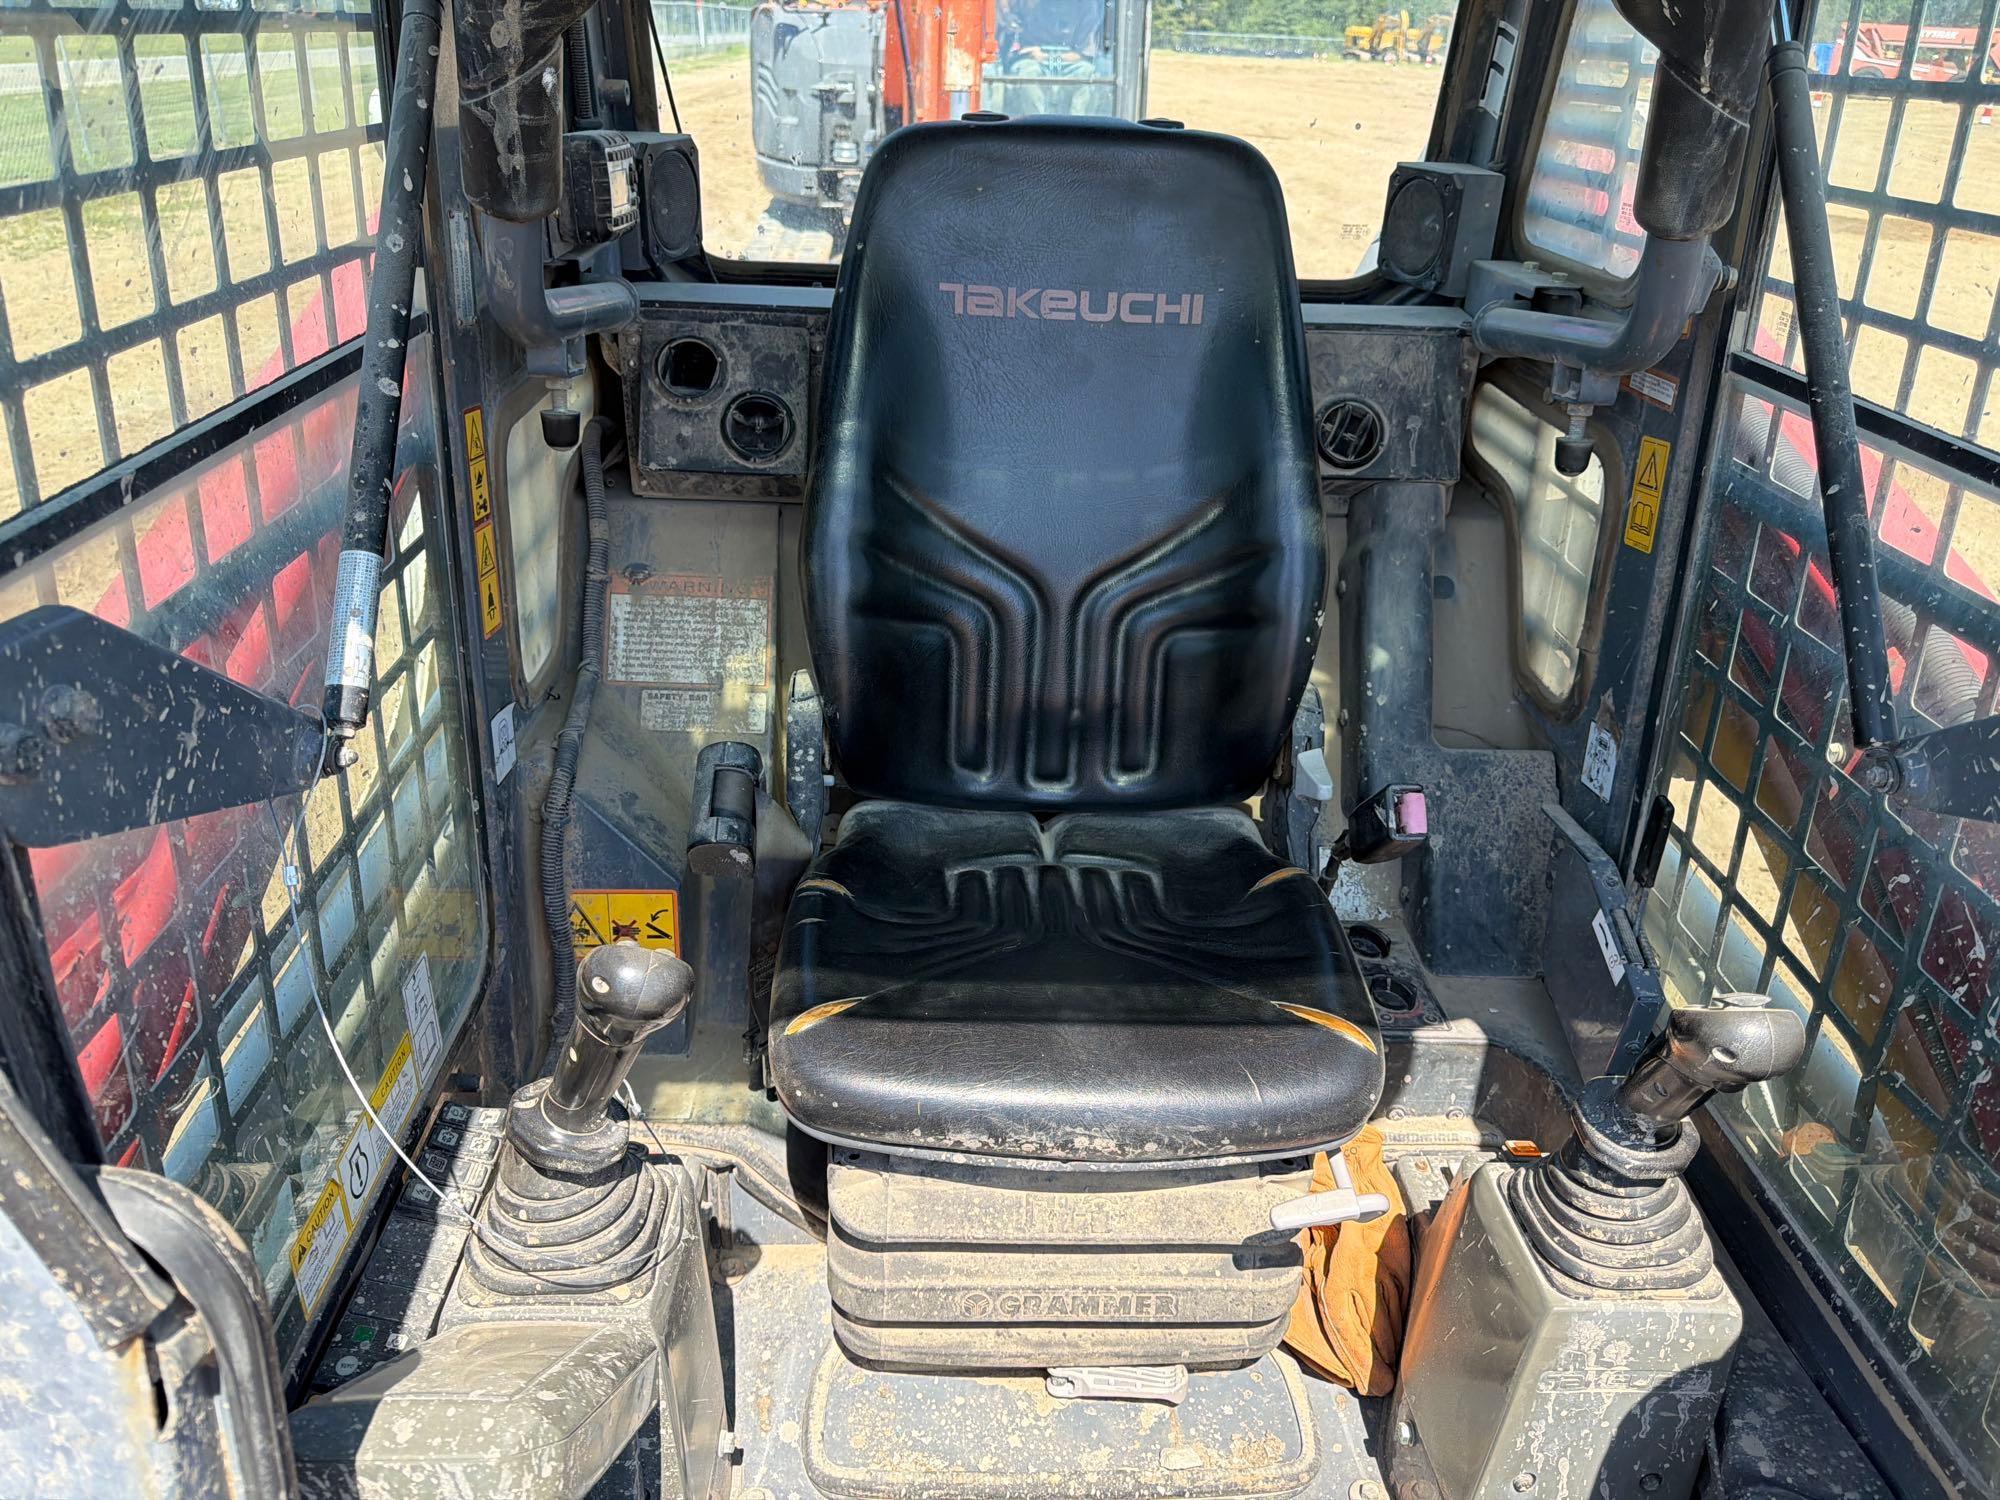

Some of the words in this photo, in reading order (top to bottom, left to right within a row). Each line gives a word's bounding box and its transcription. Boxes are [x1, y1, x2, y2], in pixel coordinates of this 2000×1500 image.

[939, 282, 1205, 325] TAKEUCHI
[380, 1048, 406, 1097] CAUTION
[306, 1188, 334, 1243] CAUTION
[1000, 1292, 1178, 1317] GRAMMER
